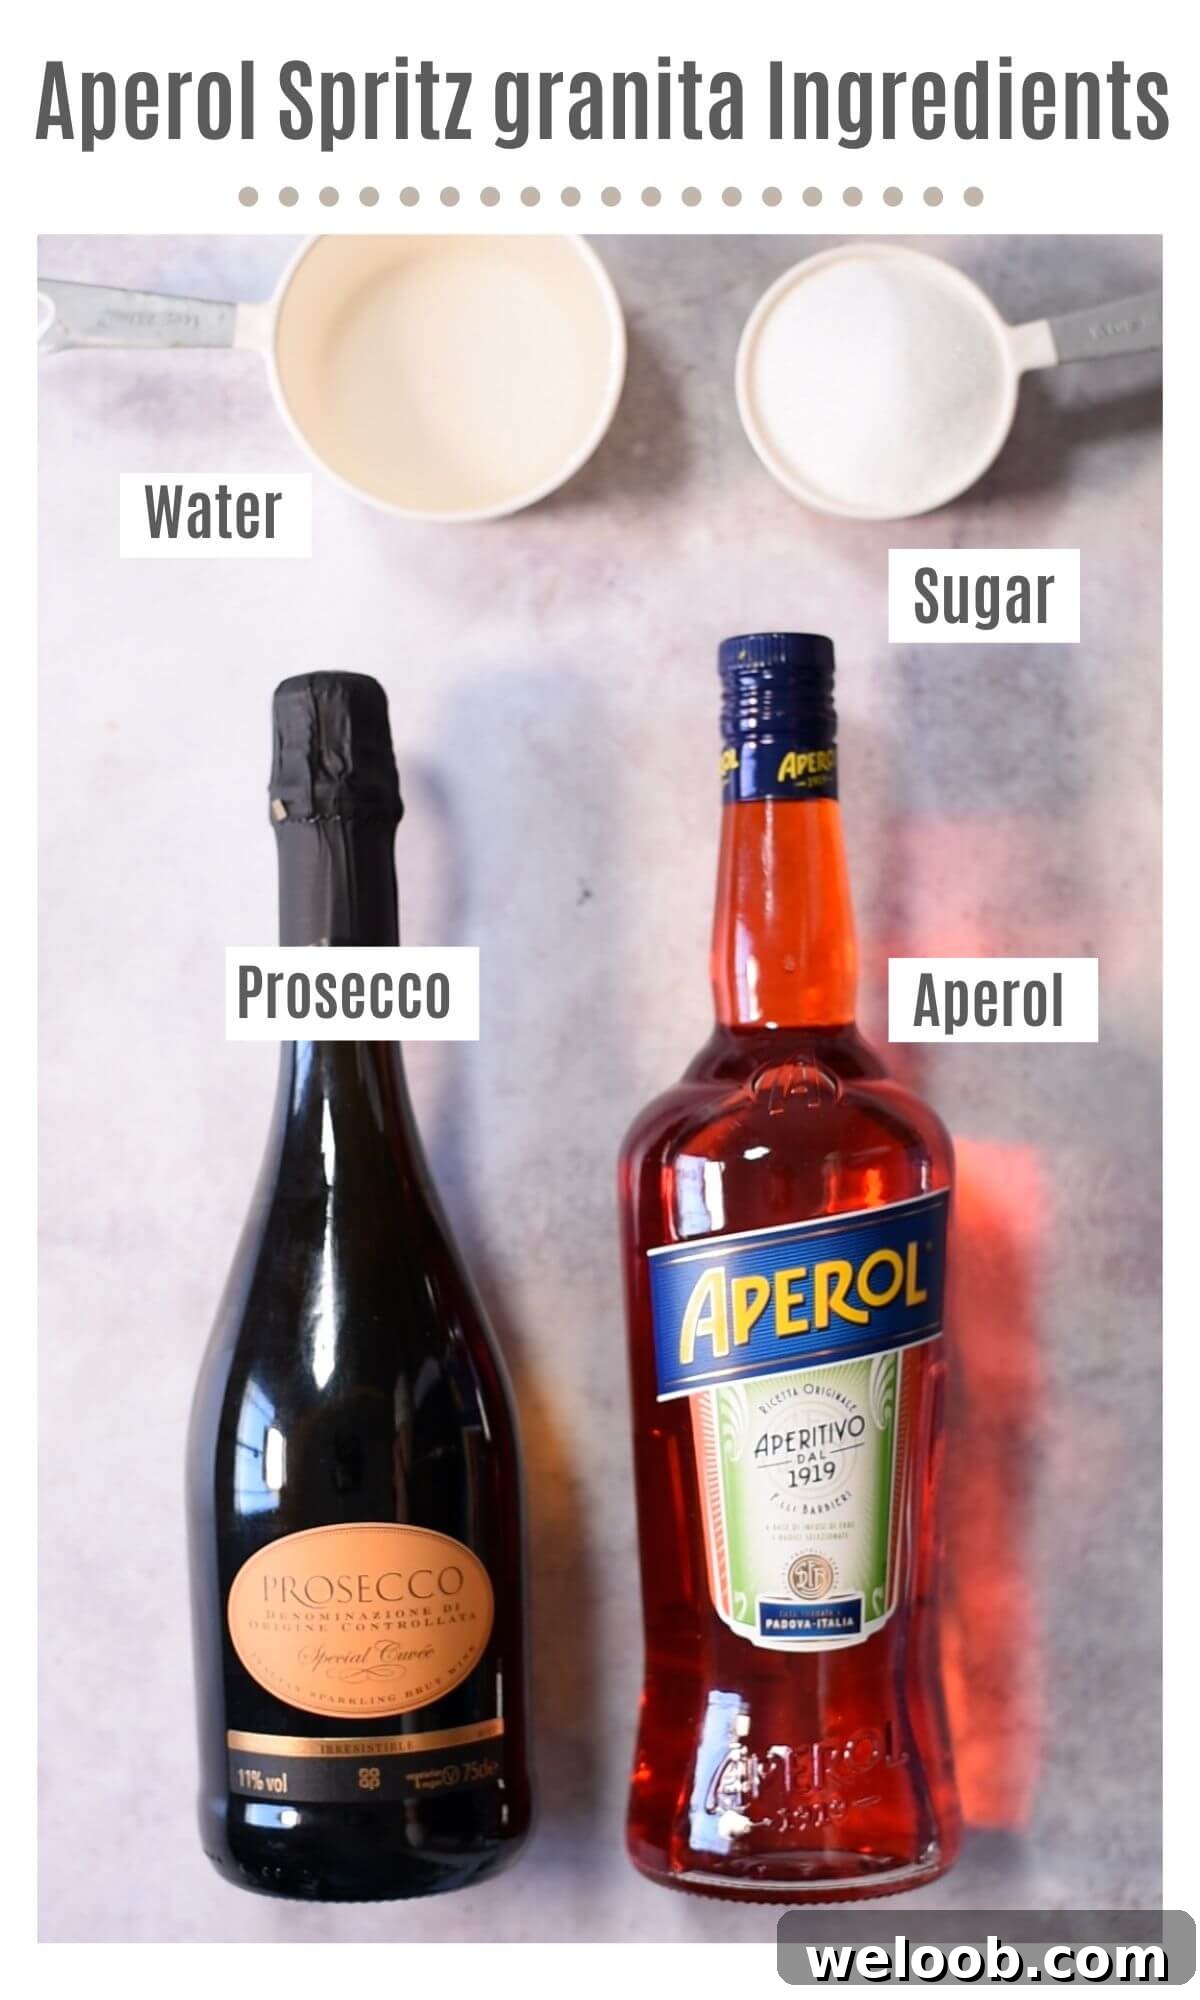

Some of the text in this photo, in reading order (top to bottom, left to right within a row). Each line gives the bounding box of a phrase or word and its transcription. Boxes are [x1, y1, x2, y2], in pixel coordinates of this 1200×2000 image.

[680, 1241, 927, 1364] APEROL
[758, 1383, 857, 1415] RICETTA ORIGINALE
[754, 1415, 866, 1459] APERITIVO
[797, 1450, 826, 1465] DAL
[788, 1461, 835, 1489] 1919
[263, 1566, 464, 1609] PROSECCO
[248, 1611, 478, 1633] ORIGINE CONTROLLATA
[265, 1602, 462, 1621] DENOMINAZIONE DI
[297, 1639, 435, 1673] Special Cuvée
[308, 1689, 397, 1705] SPARKLING
[405, 1677, 441, 1699] BRUT
[238, 1768, 288, 1793] 11% vol
